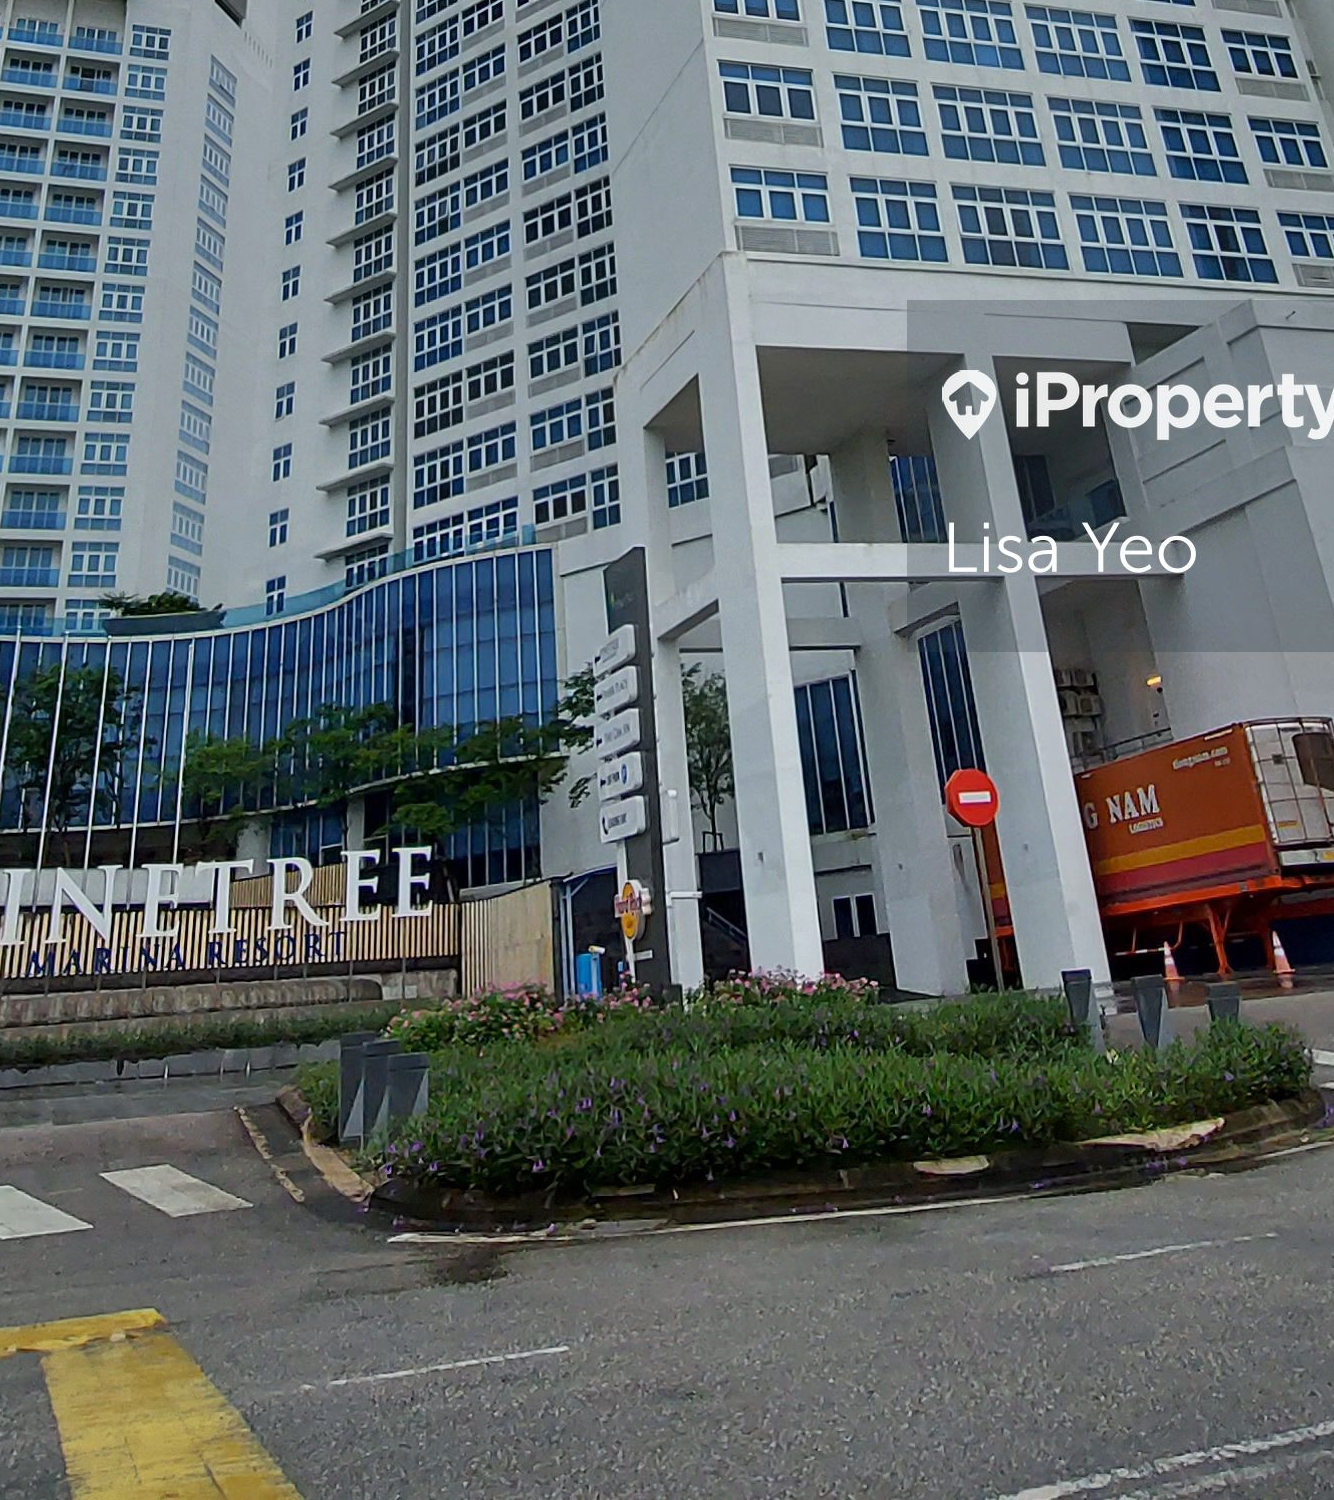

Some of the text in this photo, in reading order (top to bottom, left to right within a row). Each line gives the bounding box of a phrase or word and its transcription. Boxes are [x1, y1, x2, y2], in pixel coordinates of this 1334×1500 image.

[1105, 784, 1160, 823] NAM
[26, 930, 347, 977] MARINA RESORT
